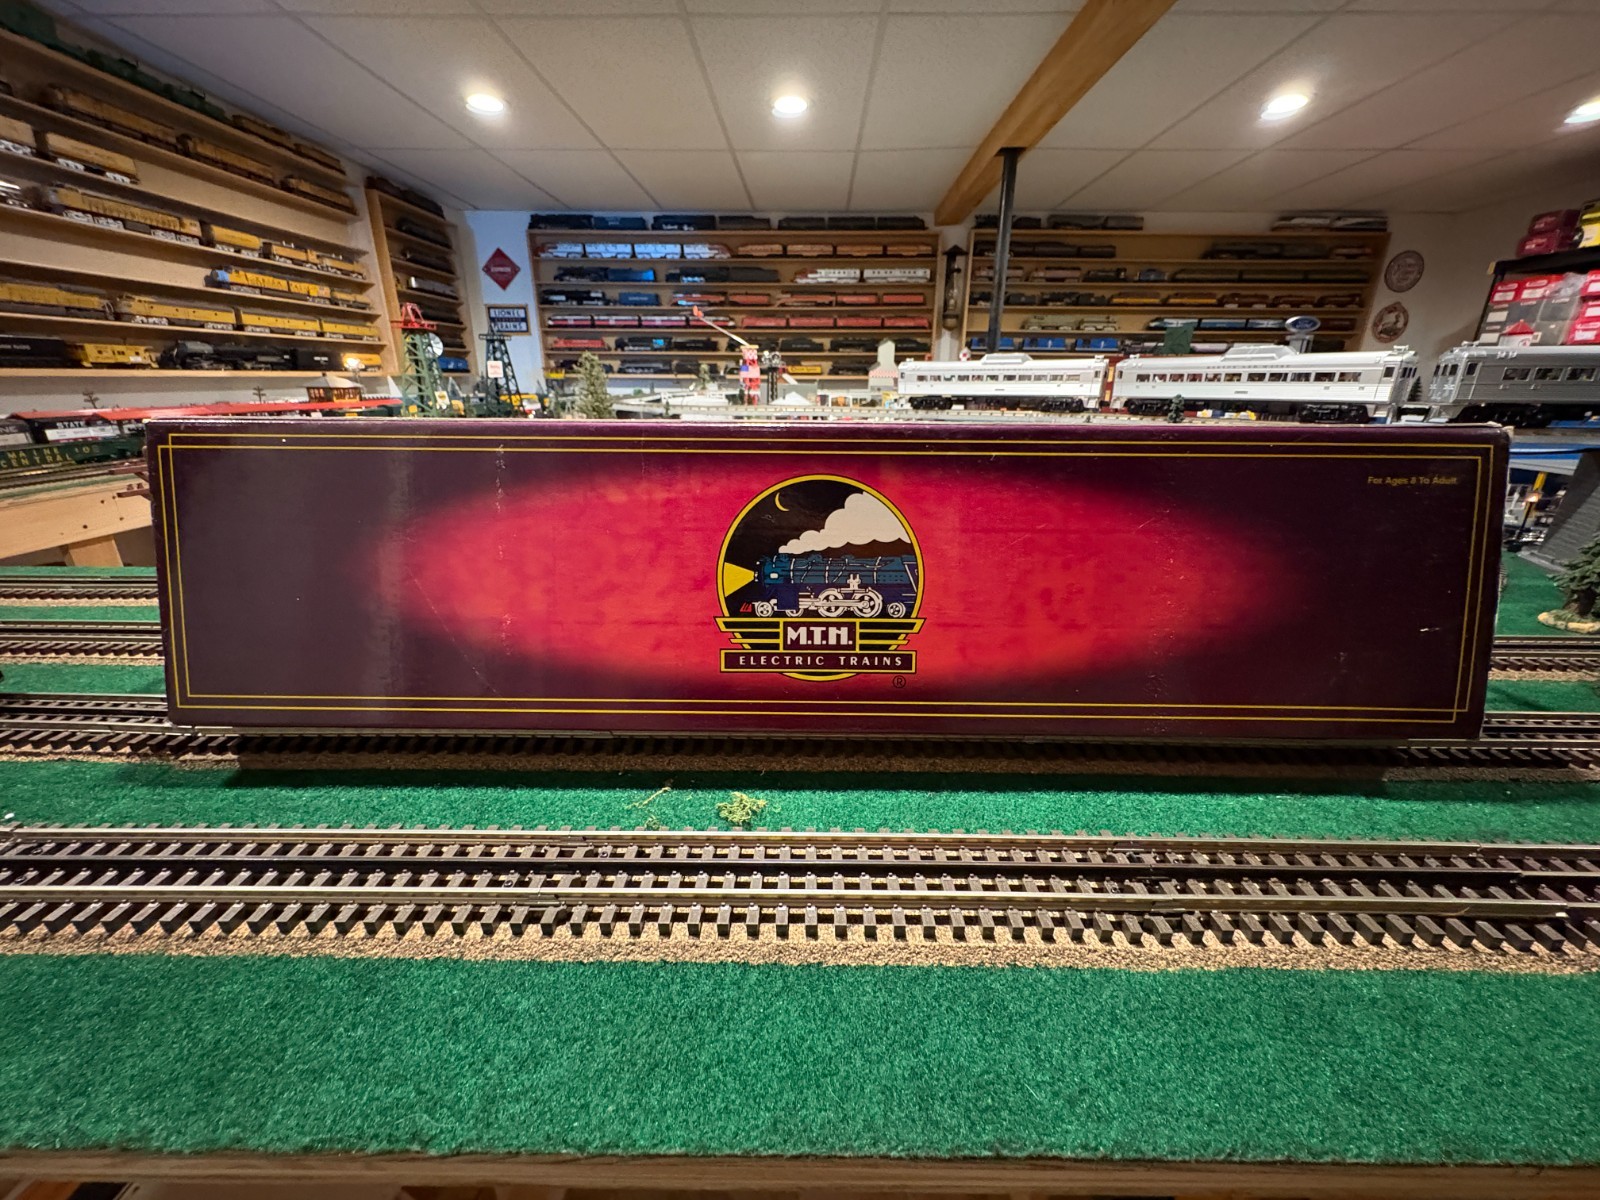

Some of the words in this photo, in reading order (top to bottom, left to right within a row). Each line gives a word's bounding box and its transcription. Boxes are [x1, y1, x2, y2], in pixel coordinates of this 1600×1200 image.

[494, 308, 521, 317] LIONEL
[7, 447, 60, 458] MAINE
[0, 453, 74, 468] CENTRAL
[1367, 476, 1382, 484] For
[1385, 476, 1408, 487] Ages
[1419, 476, 1430, 485] To
[1432, 476, 1457, 485] Adult
[739, 655, 825, 666] ELECTRIC
[839, 656, 902, 667] TRAINS
